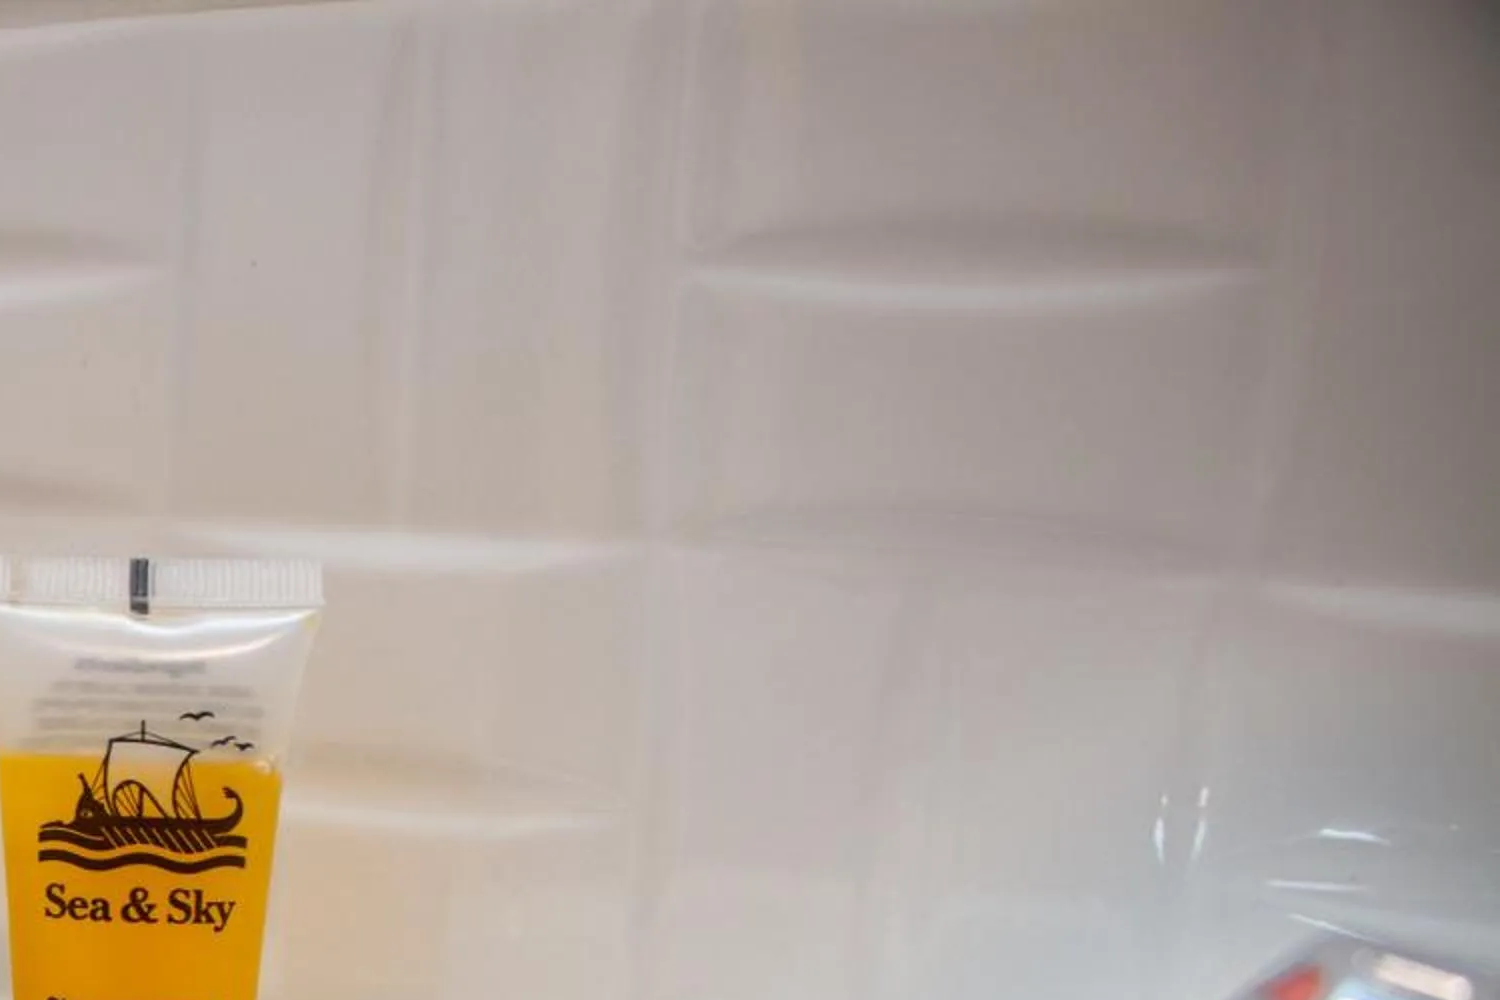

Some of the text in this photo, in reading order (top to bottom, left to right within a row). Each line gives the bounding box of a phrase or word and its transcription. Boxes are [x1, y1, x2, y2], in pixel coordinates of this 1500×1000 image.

[45, 883, 236, 932] Sea & Sky
